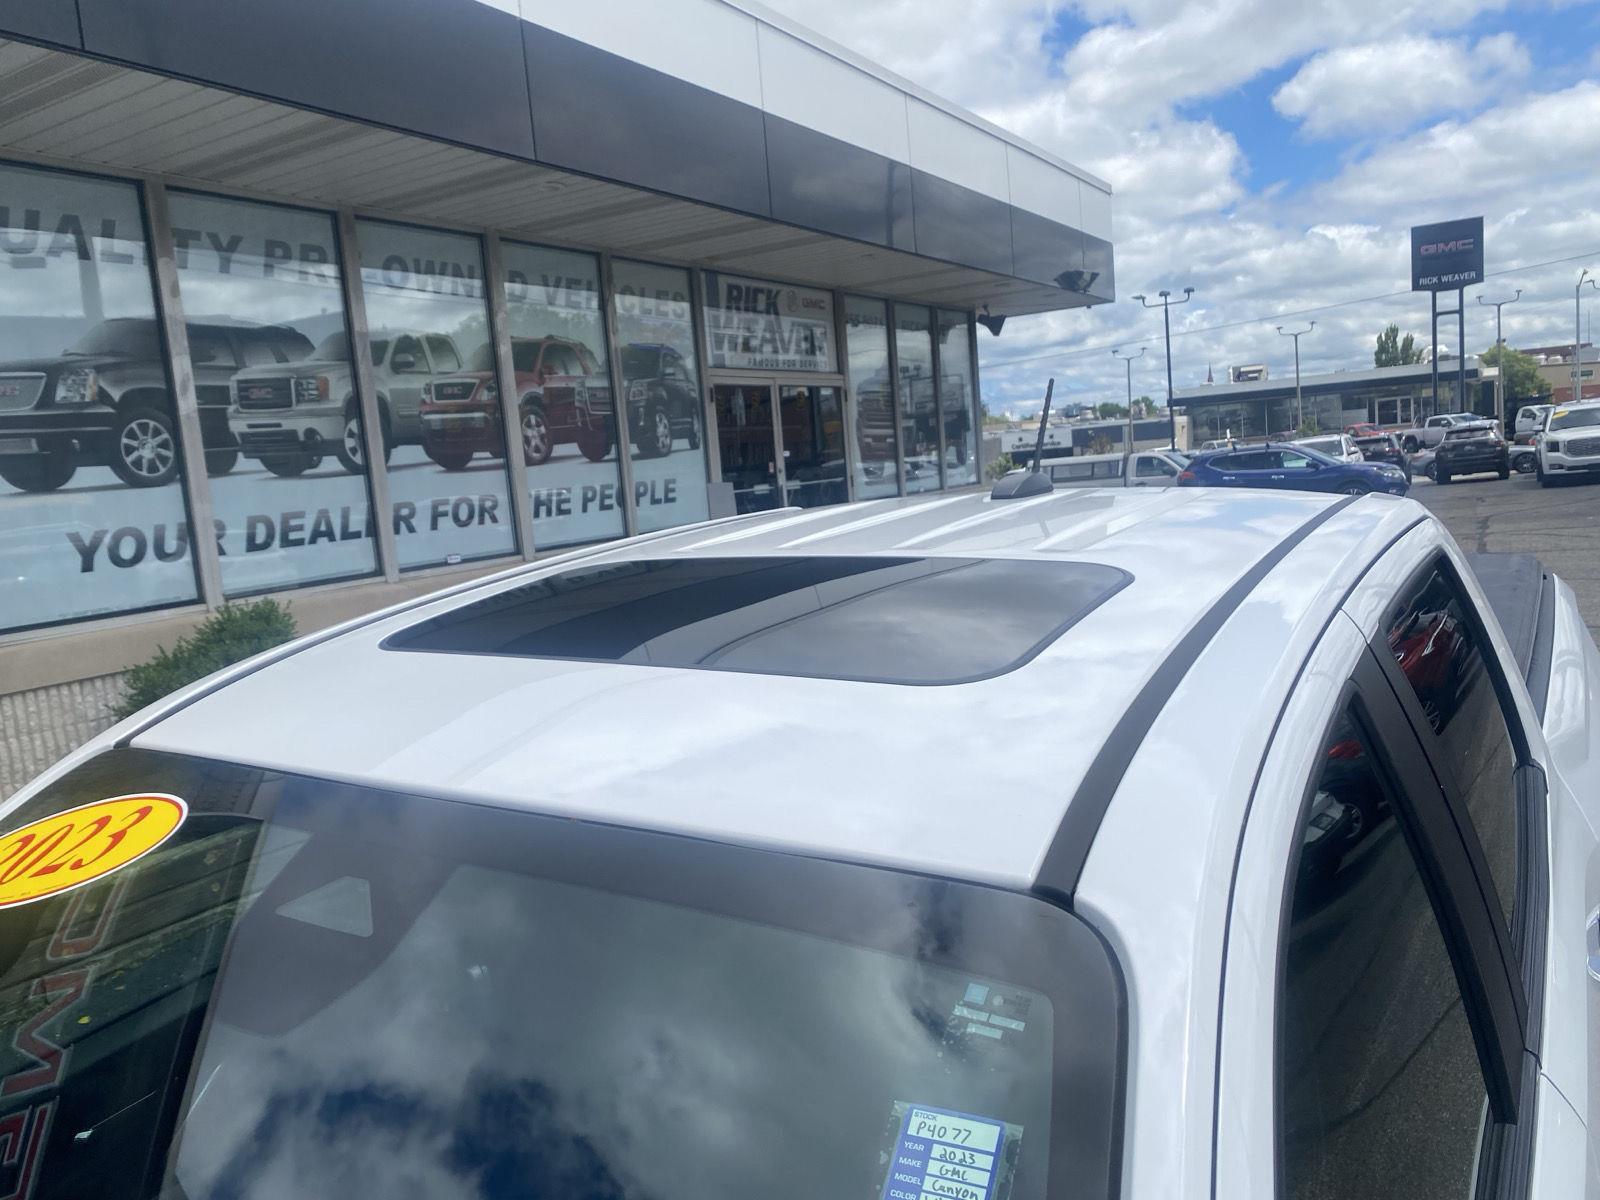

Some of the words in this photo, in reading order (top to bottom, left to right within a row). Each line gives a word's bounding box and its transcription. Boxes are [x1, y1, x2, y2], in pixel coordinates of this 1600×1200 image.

[1420, 238, 1473, 256] GMC
[0, 206, 243, 274] UALTY
[541, 274, 686, 318] VECLES
[1419, 275, 1439, 286] RICK
[1441, 271, 1476, 283] WEAVER
[725, 283, 782, 317] RICK
[429, 493, 499, 532] FOR
[530, 487, 573, 519] HE
[914, 1110, 938, 1122] STOCK
[904, 1140, 925, 1152] YEAR
[898, 1156, 923, 1168] MAKE
[939, 1147, 976, 1165] 2023
[893, 1172, 922, 1186] MODEL
[940, 1164, 969, 1181] GMC
[890, 1188, 917, 1200] COLOR
[931, 1182, 979, 1200] Canyon
